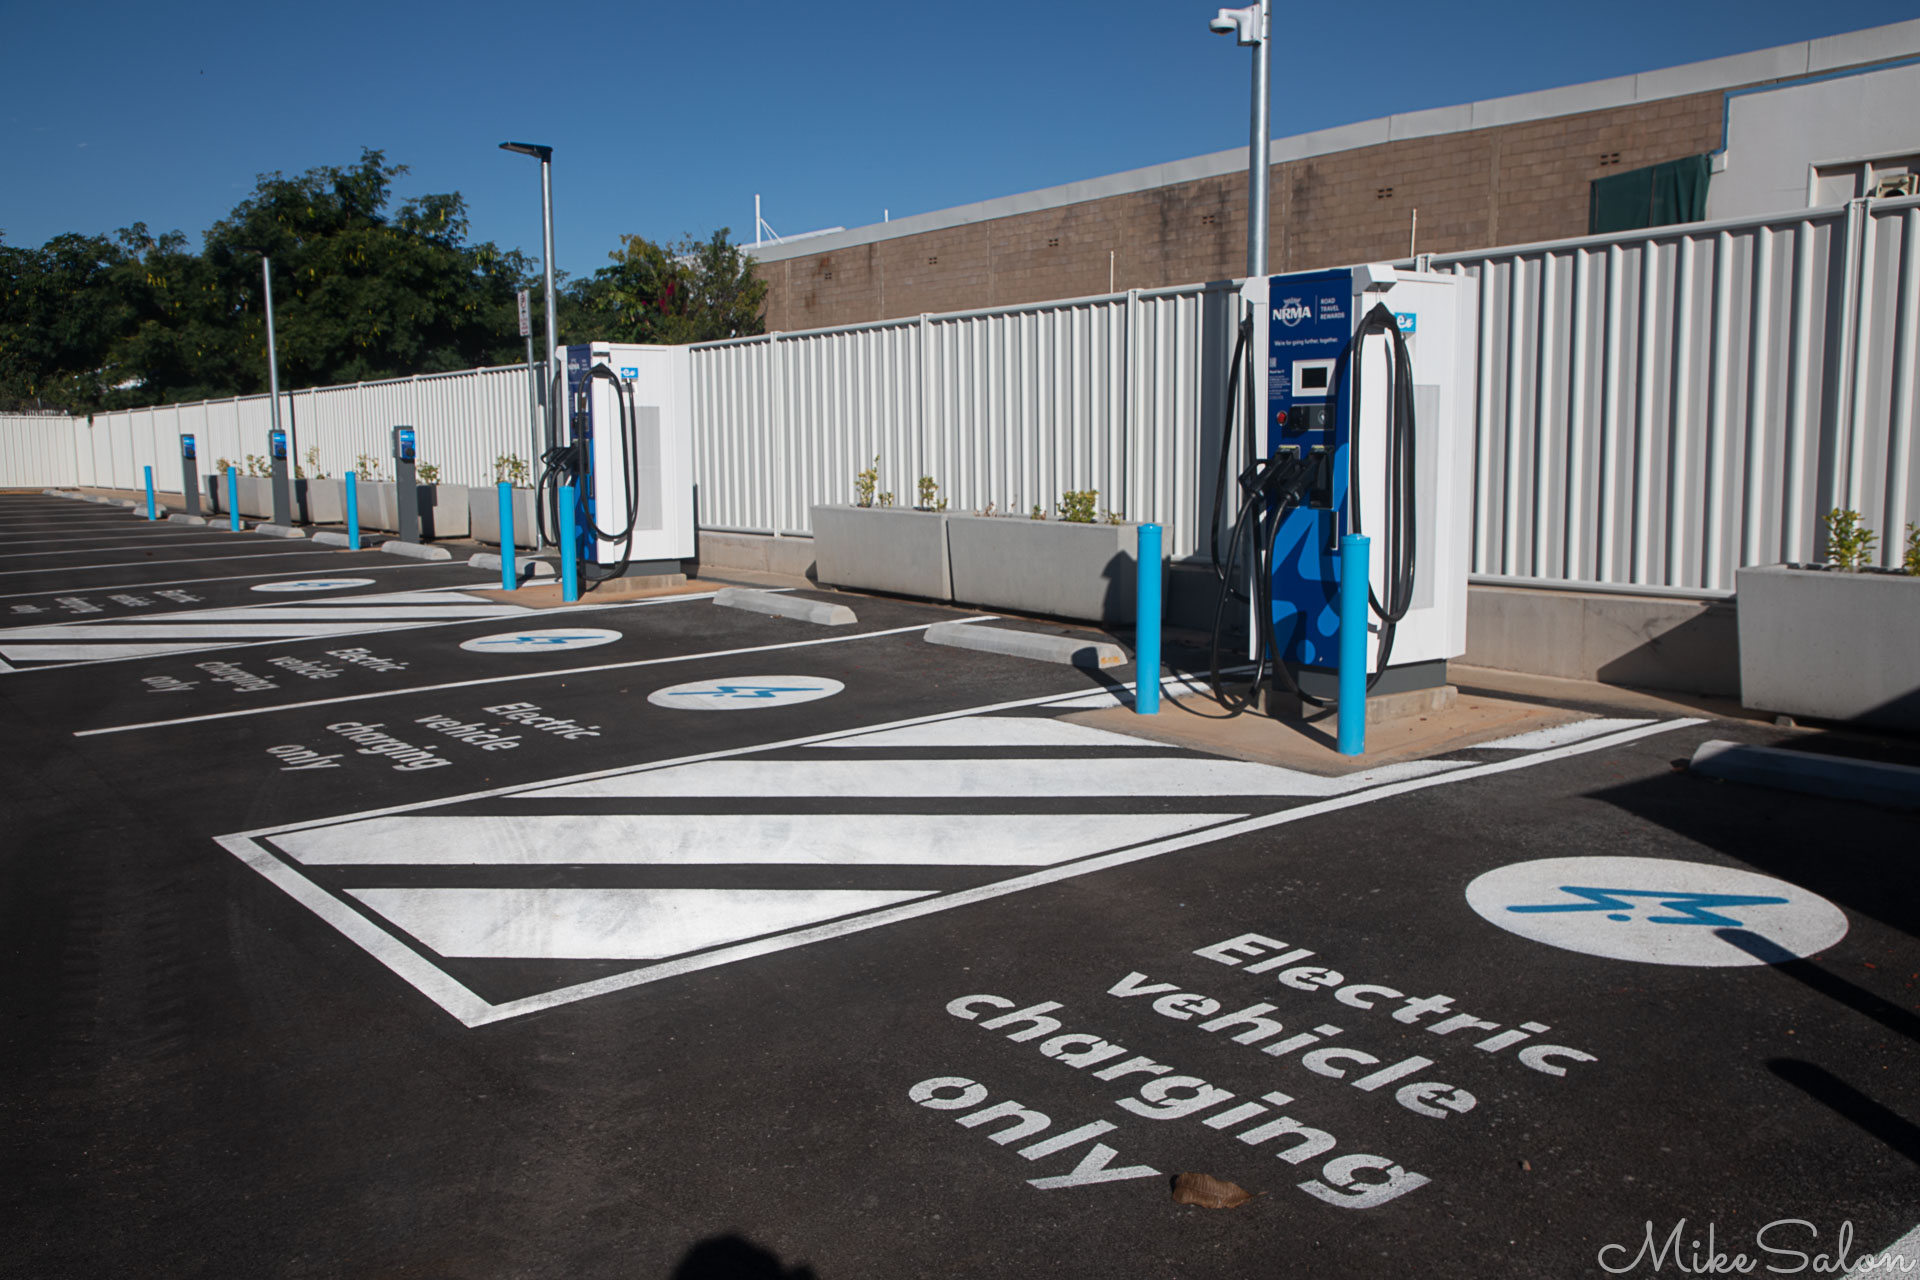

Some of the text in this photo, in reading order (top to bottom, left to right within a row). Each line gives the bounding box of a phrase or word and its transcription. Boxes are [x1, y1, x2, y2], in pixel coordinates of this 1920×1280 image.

[1272, 305, 1312, 321] NRMA
[1320, 297, 1336, 305] ROAD
[1320, 312, 1345, 320] REWARDS
[267, 656, 345, 680] vehicle
[325, 648, 410, 672] Electric
[141, 676, 200, 693] only
[195, 661, 280, 692] charging
[414, 714, 523, 751] vehicle
[482, 701, 601, 740] Electric
[266, 744, 345, 771] only
[325, 721, 453, 772] charging
[1191, 932, 1599, 1078] Electric
[1106, 970, 1478, 1120] vehicle
[945, 993, 1433, 1210] charging
[908, 1075, 1163, 1191] only
